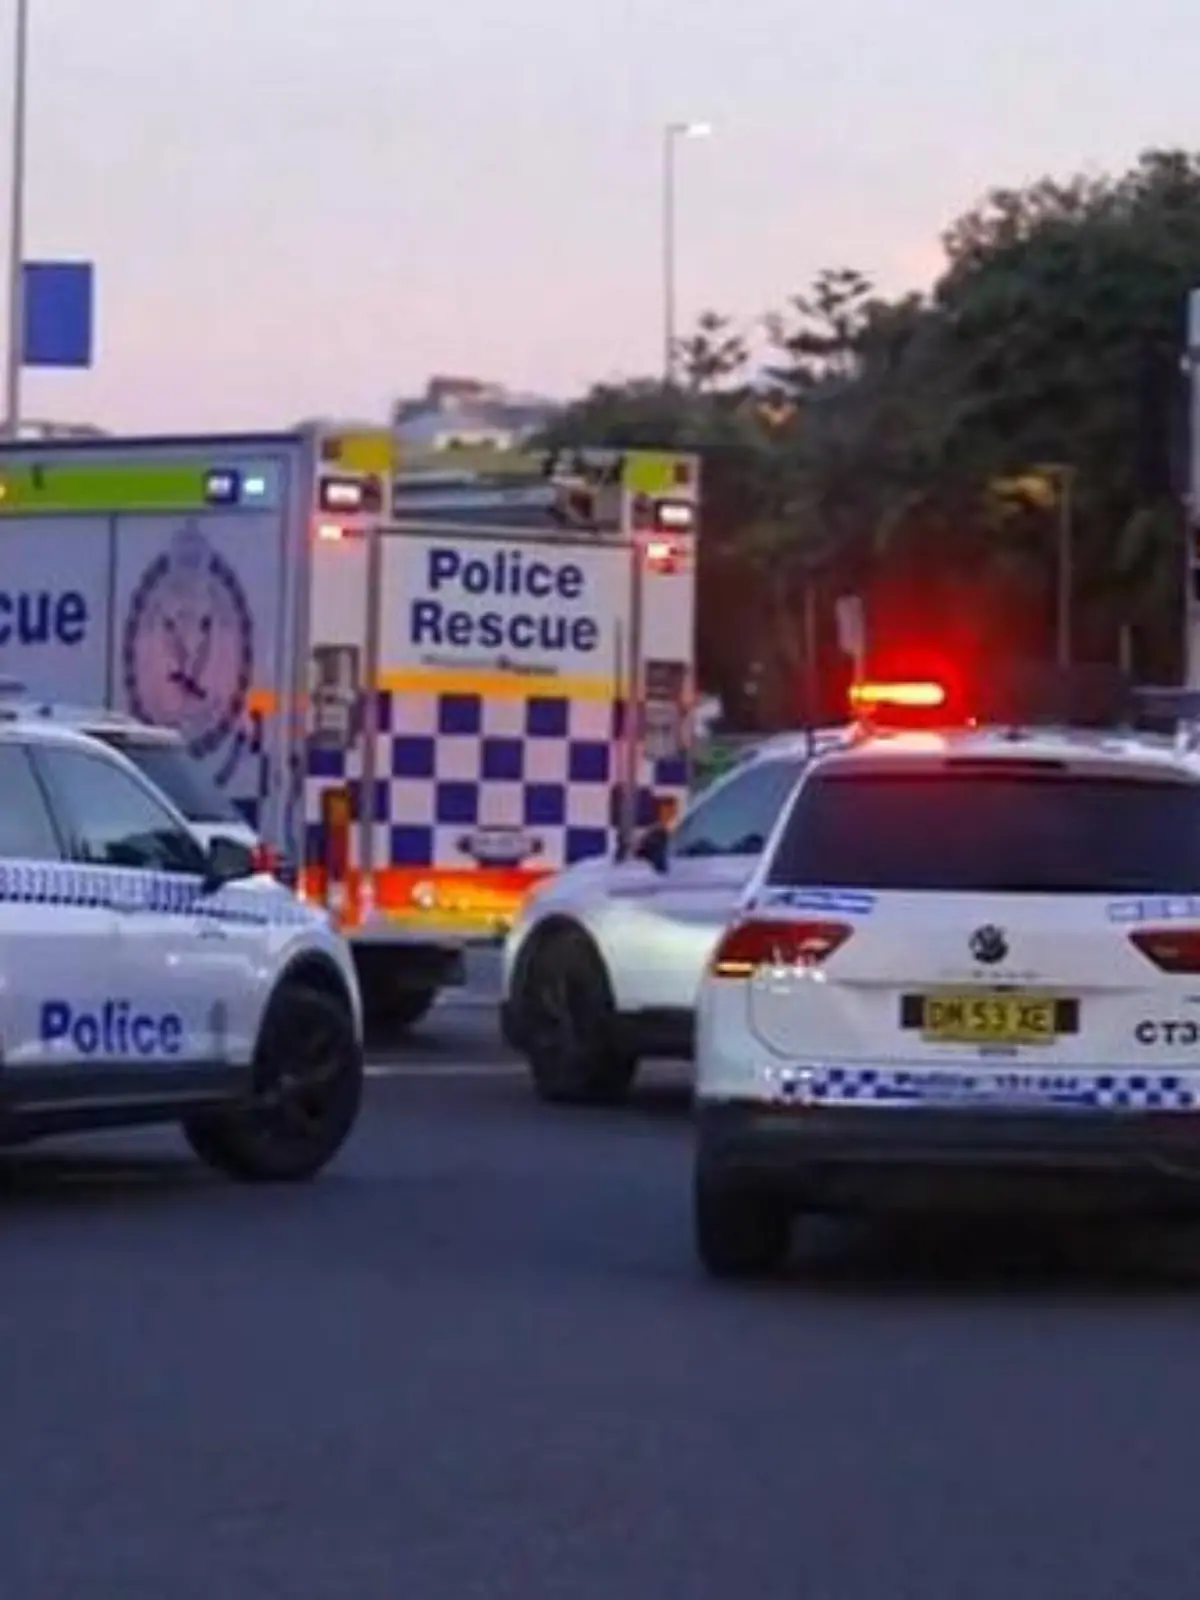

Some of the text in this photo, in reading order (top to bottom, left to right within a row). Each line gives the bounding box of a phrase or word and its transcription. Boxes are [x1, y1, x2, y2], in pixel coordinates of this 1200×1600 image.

[428, 548, 584, 599] Police
[411, 599, 598, 652] Rescue
[41, 998, 183, 1054] Police
